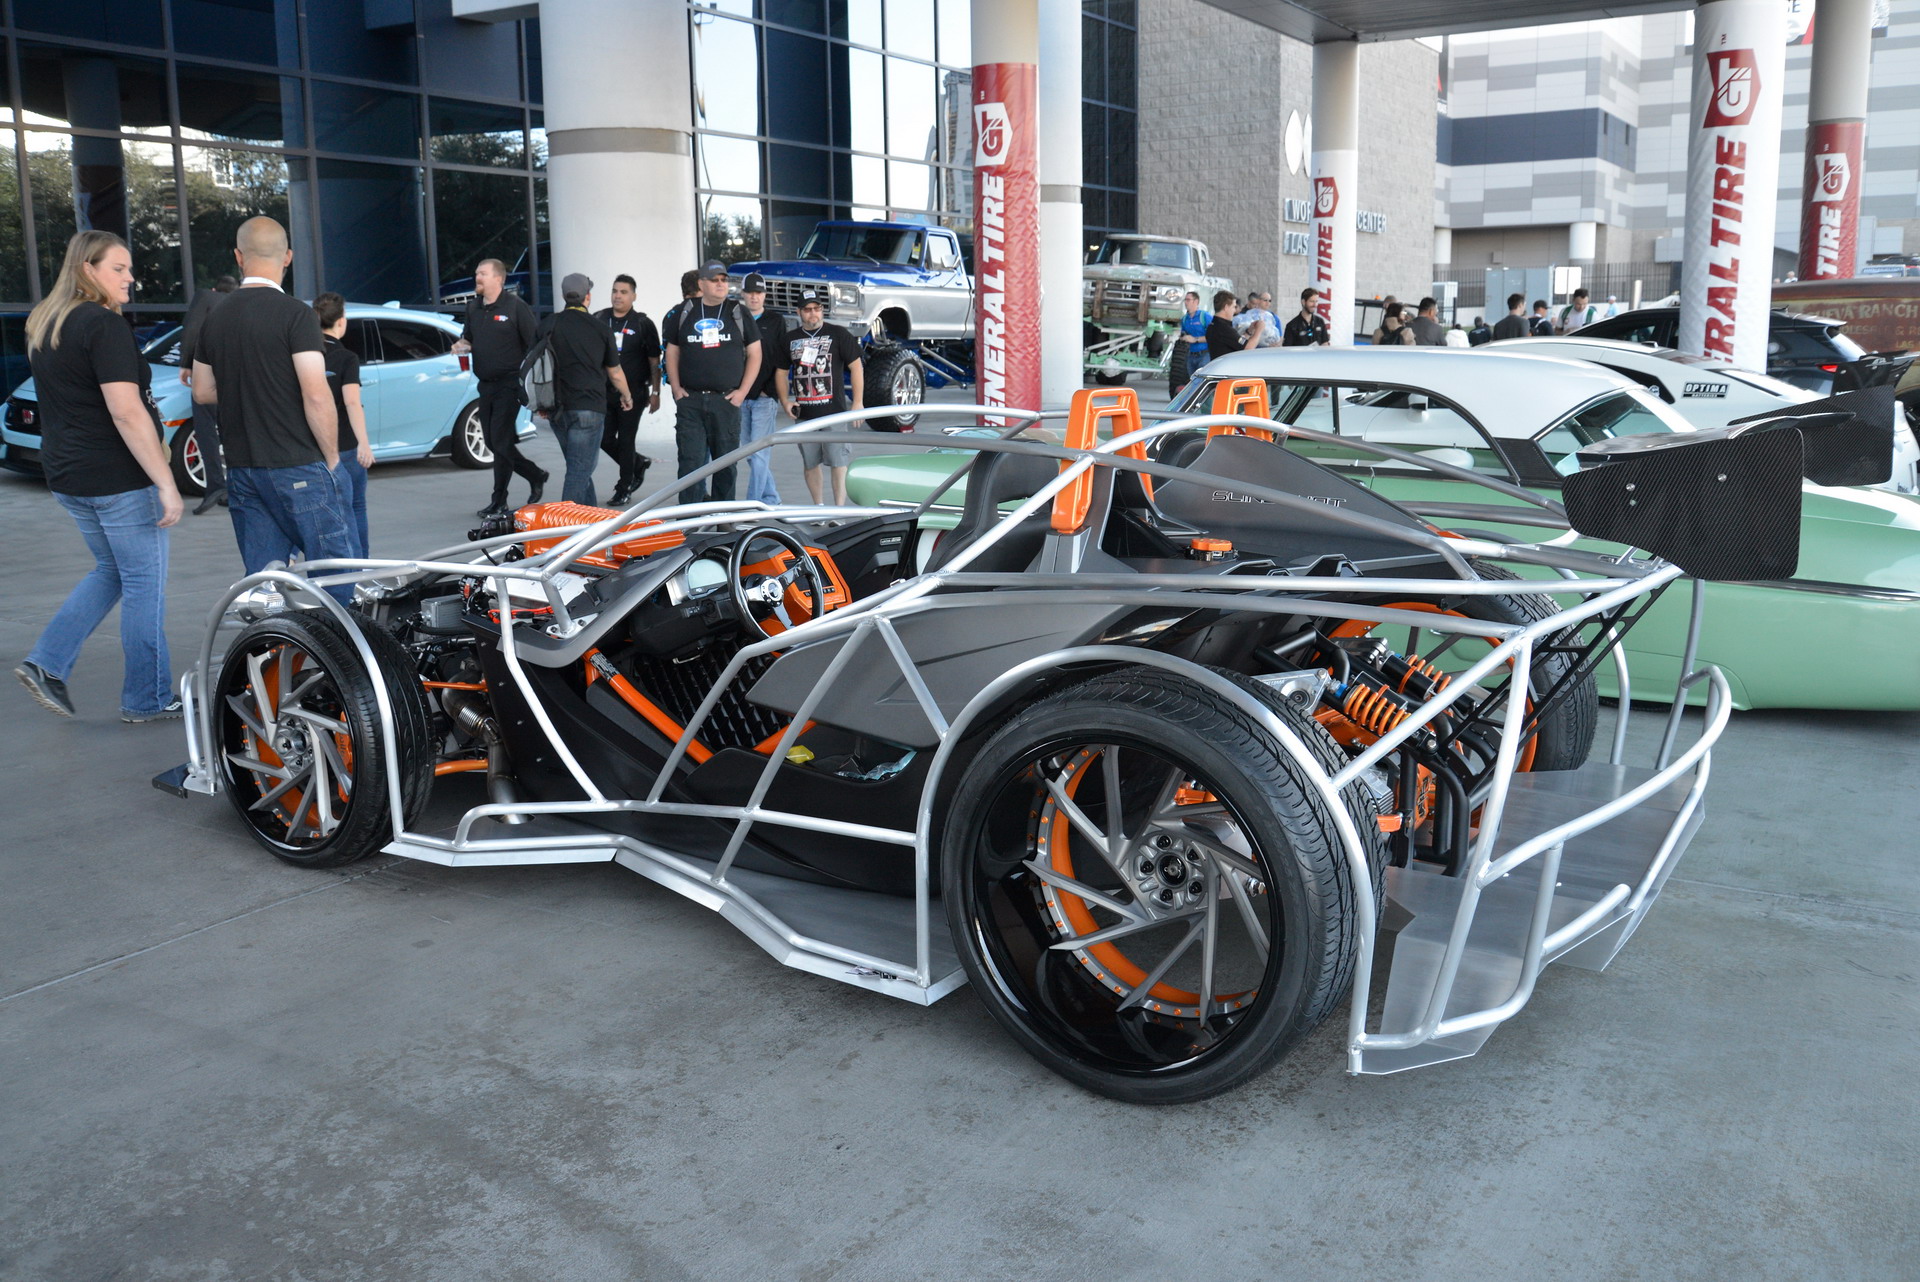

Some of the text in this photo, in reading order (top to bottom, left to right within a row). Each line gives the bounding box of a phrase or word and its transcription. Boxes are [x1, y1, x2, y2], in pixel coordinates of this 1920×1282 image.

[1357, 210, 1387, 232] CENTER
[1710, 135, 1747, 247] TIRE
[1316, 222, 1333, 283] TIRE
[1816, 205, 1842, 276] TIRE
[982, 172, 1006, 427] ENERAL TIRE
[1703, 257, 1740, 363] RAL
[1858, 303, 1919, 320] RANCH
[687, 333, 731, 343] SURU
[1685, 383, 1727, 394] OPTIMA
